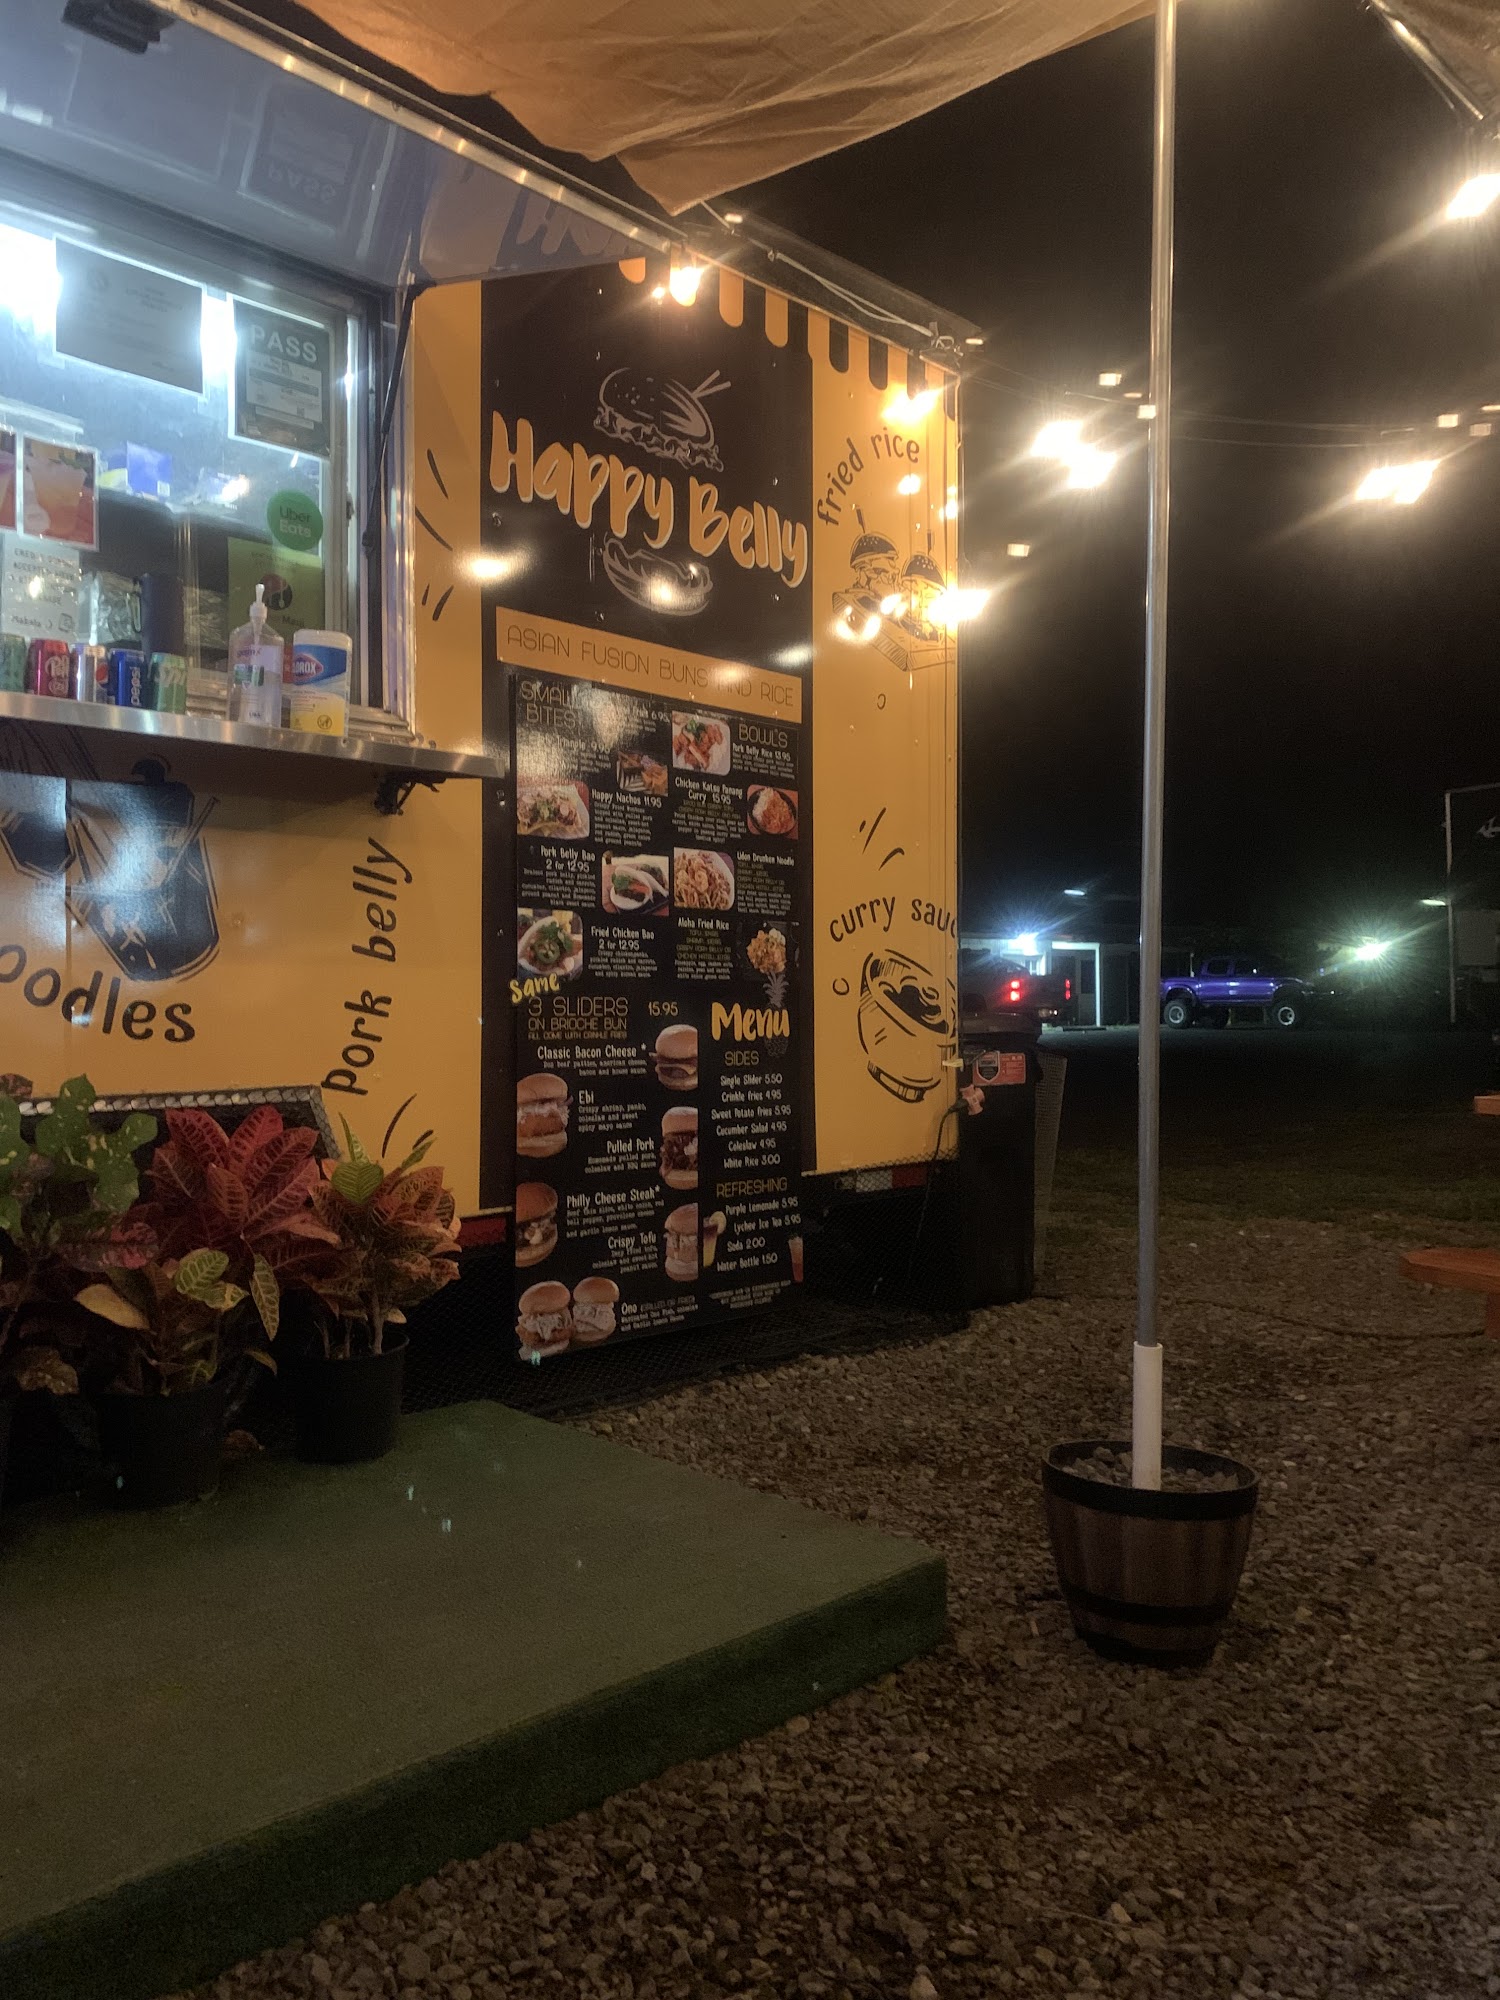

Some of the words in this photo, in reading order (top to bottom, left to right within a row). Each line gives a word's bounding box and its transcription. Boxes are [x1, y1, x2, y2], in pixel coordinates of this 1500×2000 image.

[250, 324, 318, 363] PASS
[817, 437, 864, 526] fried
[870, 427, 920, 463] rice
[489, 410, 675, 549] Happy
[688, 476, 808, 588] Belly
[279, 505, 312, 523] Uber
[279, 519, 312, 538] Eats
[507, 625, 570, 658] ASIAN
[581, 642, 650, 676] FUSION
[659, 659, 709, 688] BUNS
[717, 675, 753, 698] AND
[760, 684, 794, 707] RICE
[526, 702, 577, 729] BITES
[591, 789, 613, 804] Happy
[615, 791, 642, 806] Nachos
[675, 777, 700, 790] Chicken
[722, 785, 743, 800] Panang
[688, 790, 707, 805] Curry
[540, 844, 557, 858] Pork
[559, 847, 579, 861] Belly
[581, 850, 596, 862] Bao
[545, 860, 553, 870] 2
[555, 861, 565, 870] for
[352, 837, 413, 963] belly
[677, 917, 696, 928] Aloha
[697, 918, 714, 930] Fried
[715, 919, 730, 931] Rice
[829, 896, 896, 942] curry
[591, 925, 610, 938] Fried
[612, 926, 640, 939] Chicken
[641, 928, 655, 940] Bao
[598, 939, 605, 950] 2
[607, 940, 616, 950] for
[528, 996, 543, 1017] 3
[553, 996, 629, 1017] SLIDERS
[648, 1001, 679, 1017] 15.95
[528, 1017, 545, 1031] ON
[550, 1017, 599, 1031] BRIOCHE
[603, 1017, 627, 1030] BUN
[711, 1001, 790, 1041] Menu
[321, 988, 393, 1096] pork
[537, 1045, 571, 1059] Classic
[575, 1045, 602, 1059] Bacon
[605, 1044, 637, 1058] Cheese
[725, 1051, 760, 1067] SIDES
[720, 1074, 740, 1089] Single
[743, 1073, 762, 1086] Slider
[578, 1089, 595, 1105] Ebi
[721, 1090, 745, 1103] Crinkle
[711, 1108, 732, 1121] Sweet
[734, 1107, 755, 1119] Potato
[716, 1123, 749, 1137] Cucumber
[750, 1121, 769, 1134] Salad
[606, 1138, 633, 1154] Pulled
[636, 1136, 655, 1152] Pork
[728, 1139, 758, 1152] Coleslaw
[723, 1156, 743, 1169] White
[744, 1155, 759, 1167] Rice
[716, 1176, 788, 1199] REFRESHING
[566, 1193, 591, 1209] Philly
[594, 1191, 627, 1206] Cheese
[725, 1202, 747, 1217] Purple
[748, 1199, 780, 1213] Lemonade
[733, 1220, 757, 1236] Lychee
[758, 1217, 770, 1230] Ice
[607, 1235, 636, 1250] Crispy
[639, 1230, 657, 1245] Tofu
[726, 1240, 744, 1252] Soda
[716, 1260, 738, 1272] Water
[739, 1255, 760, 1269] Bottle
[621, 1301, 638, 1316] Ono
